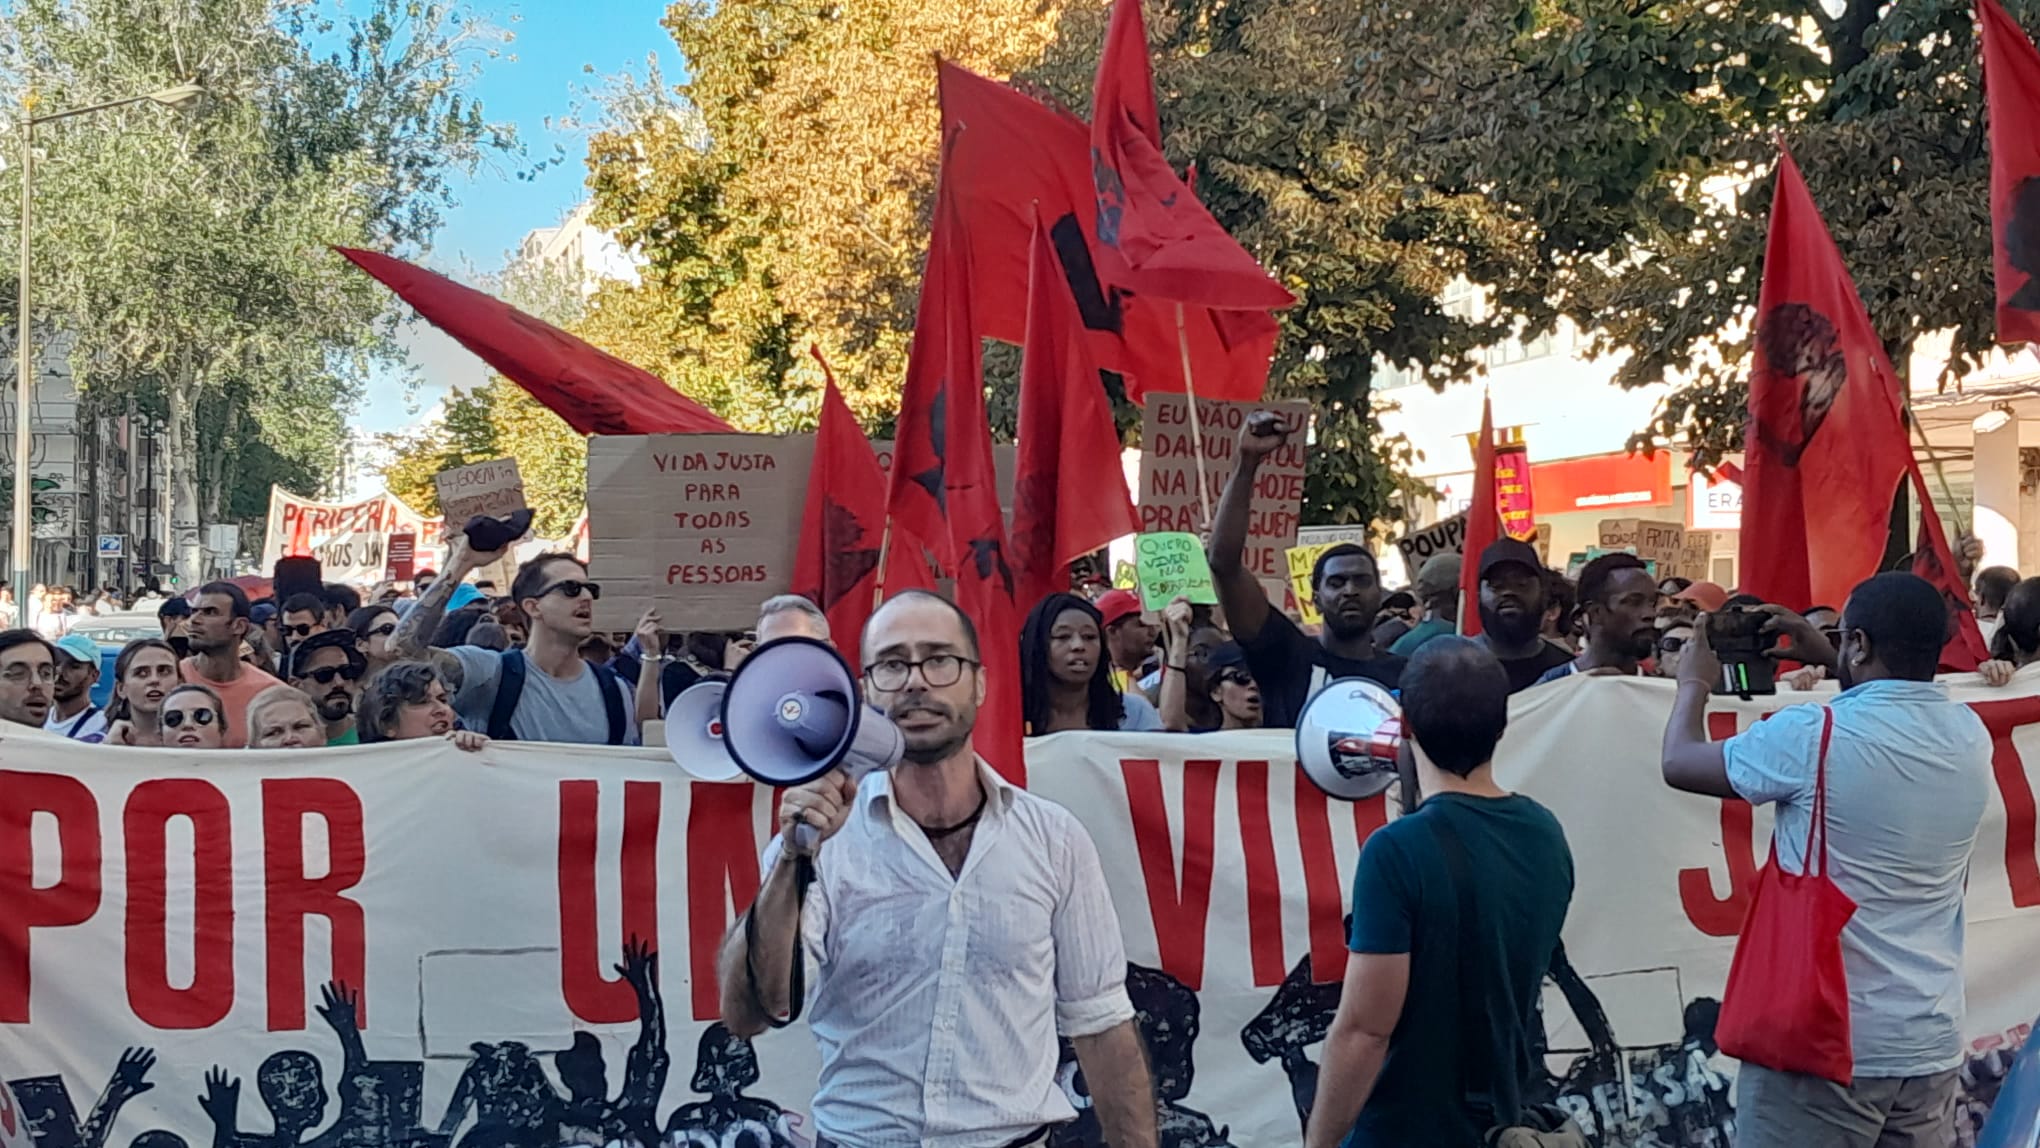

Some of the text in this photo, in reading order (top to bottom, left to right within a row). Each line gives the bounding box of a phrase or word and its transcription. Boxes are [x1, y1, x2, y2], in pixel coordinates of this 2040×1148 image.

[1158, 404, 1187, 425] EU
[653, 452, 776, 473] VIDA JUSTA
[685, 483, 740, 502] PARA
[1152, 469, 1187, 497] NA
[674, 511, 751, 530] TODAS
[701, 538, 726, 554] AS
[666, 564, 768, 585] PESSOAS
[0, 770, 366, 1032] POR
